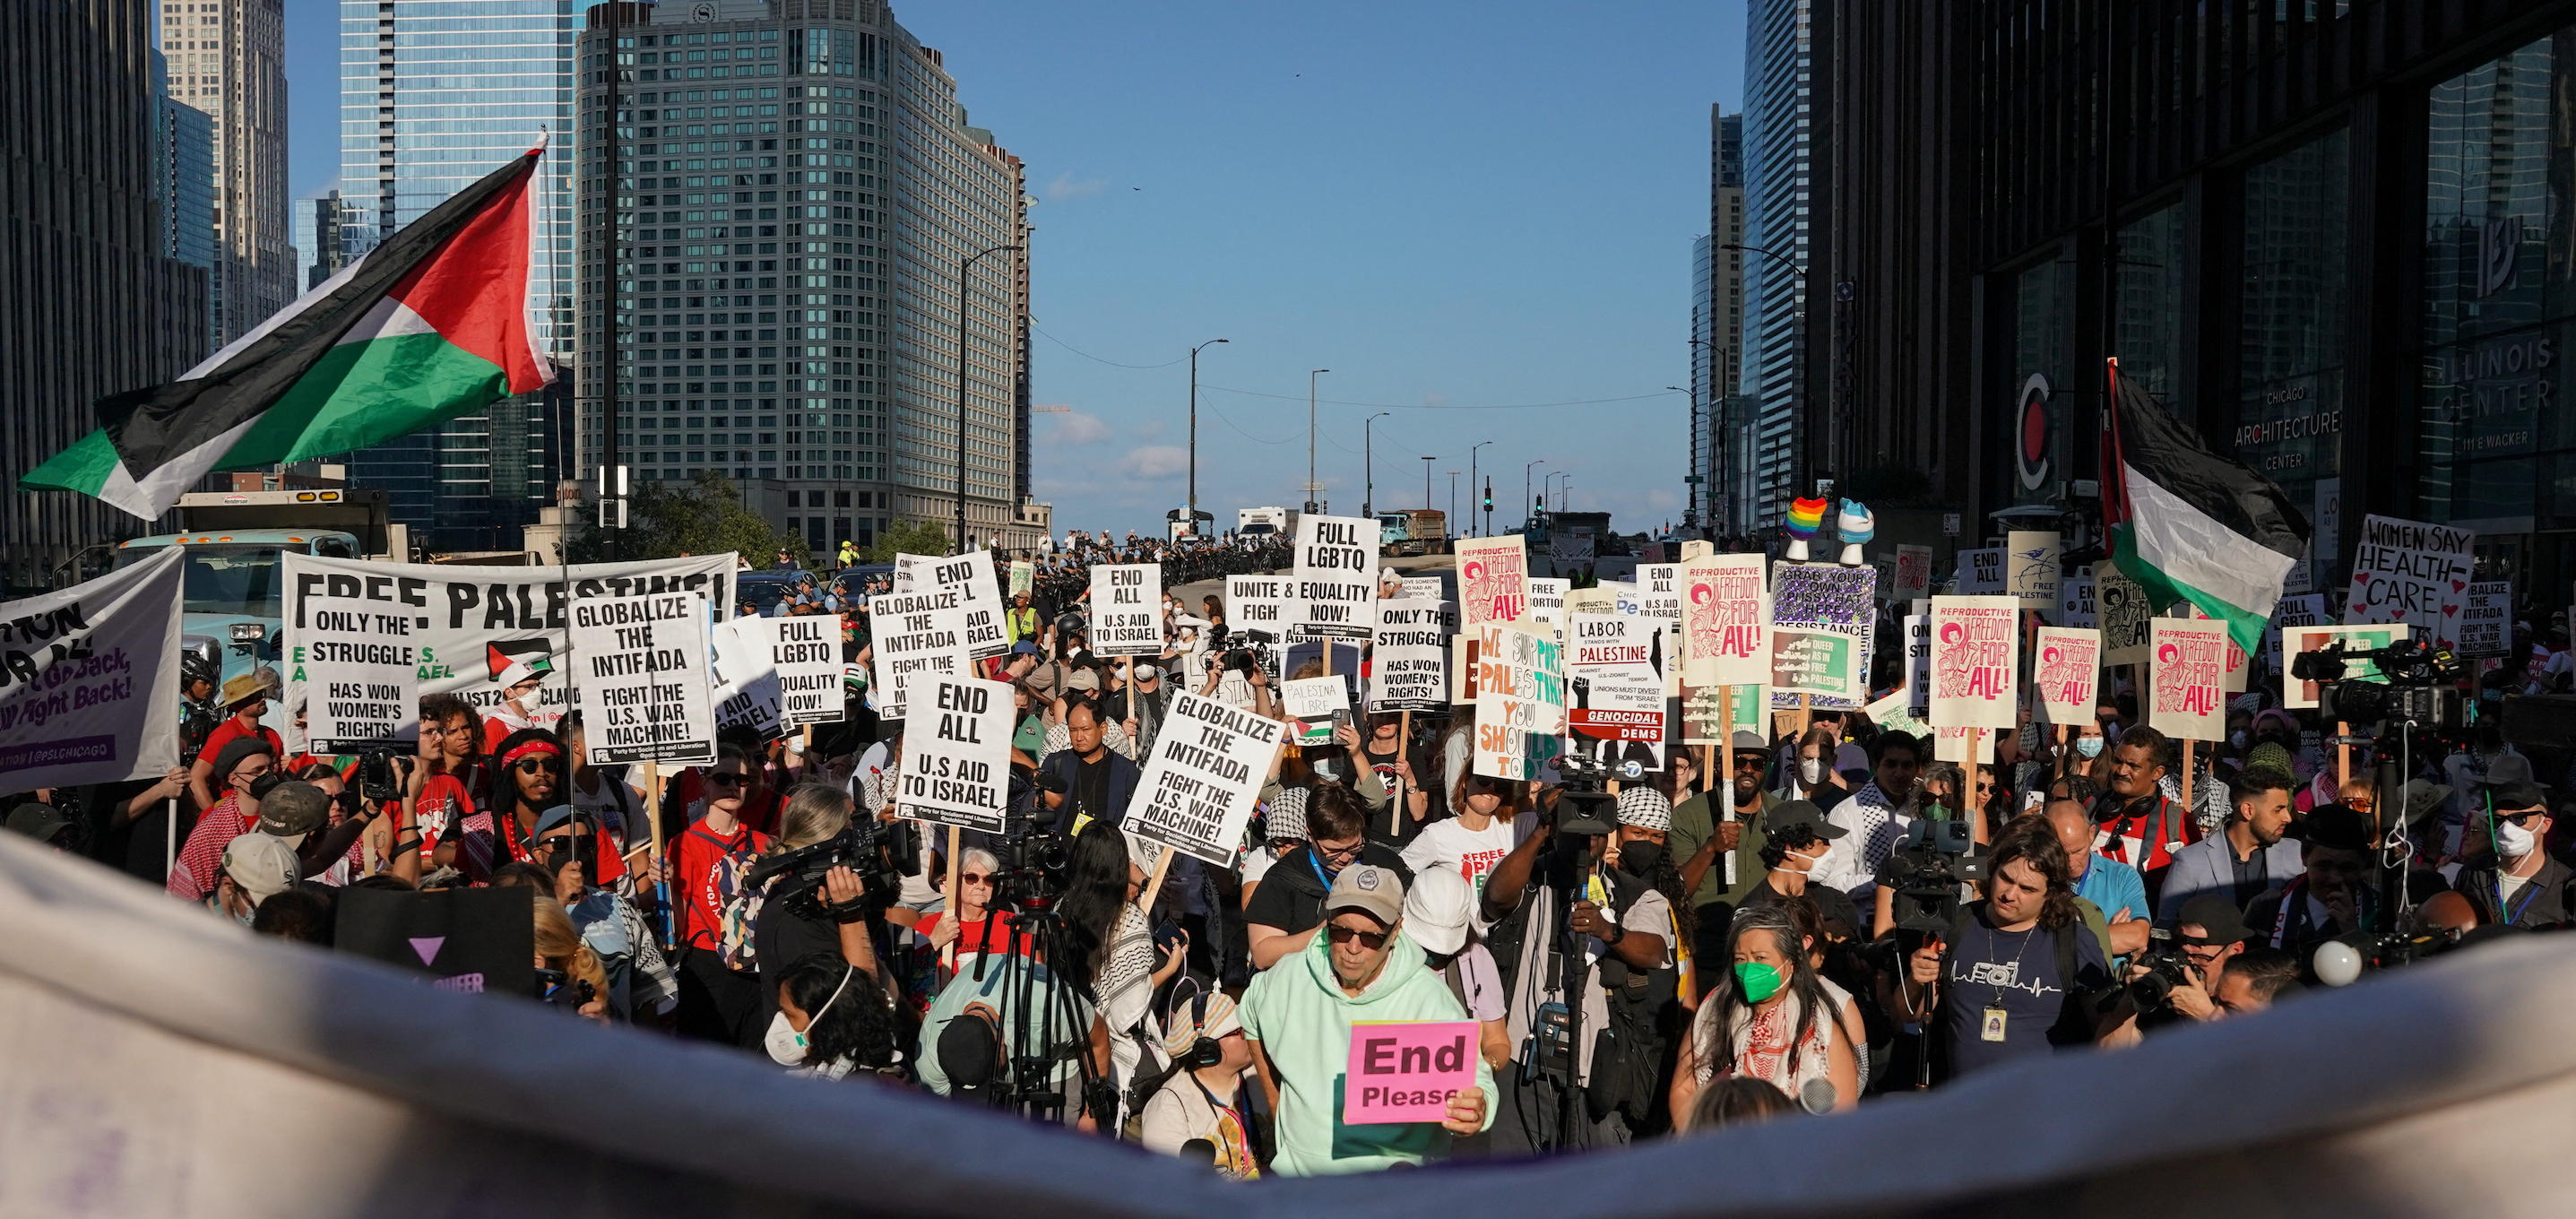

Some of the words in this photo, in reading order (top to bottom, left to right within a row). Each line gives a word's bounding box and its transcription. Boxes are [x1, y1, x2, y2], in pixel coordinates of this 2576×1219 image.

[1834, 311, 1858, 430] HYATT
[2442, 338, 2551, 385] ILLINOIS
[2267, 387, 2304, 405] CHICAGO
[2441, 380, 2549, 421] CENTER
[2235, 411, 2339, 447] ARCHITECTURE
[2462, 437, 2475, 451] 111
[2477, 437, 2484, 449] E
[2486, 431, 2529, 448] WACKER
[2266, 454, 2303, 471] CENTER
[1317, 522, 1358, 545] FULL
[2368, 519, 2425, 550] WOMEN
[2429, 526, 2470, 553] SAY
[1308, 546, 1364, 573] LGBTQ
[1462, 546, 1520, 557] REPRODUCTIVE
[1974, 552, 1999, 568] END
[936, 561, 973, 584] END
[1488, 554, 1522, 575] FREEDOM
[1650, 567, 1673, 579] END
[1690, 567, 1759, 577] REPRODUCTIVE
[2359, 546, 2467, 583] HEALTH-
[1111, 570, 1142, 585] END
[1498, 574, 1523, 594] FOR
[1783, 570, 1820, 582] GRAB
[1830, 572, 1864, 584] YOUR
[1976, 567, 1999, 583] ALL
[1114, 588, 1141, 604] ALL
[1234, 582, 1278, 598] UNITE
[1301, 582, 1370, 602] EQUALITY
[1532, 584, 1555, 594] FREE
[1653, 581, 1673, 592] ALL
[1719, 576, 1759, 600] FREEDOM
[1810, 583, 1841, 592] OWN
[2366, 578, 2437, 613] CARE
[875, 592, 958, 616] GLOBALIZE
[1491, 593, 1526, 621] ALL!
[1646, 599, 1661, 609] U.S
[1664, 599, 1678, 609] AID
[1787, 592, 1830, 603] PUSSY
[1835, 593, 1863, 603] HAT
[576, 597, 688, 627] GLOBALIZE
[967, 610, 990, 627] AID
[1310, 604, 1350, 622] NOW!
[1384, 610, 1421, 624] ONLY
[1426, 610, 1454, 627] THE
[1731, 601, 1759, 625] FOR
[1805, 604, 1840, 615] HERE
[1941, 608, 2012, 617] REPRODUCTIVE
[316, 610, 369, 633] ONLY
[376, 614, 409, 635] THE
[904, 614, 933, 631] THE
[1104, 614, 1125, 627] U.S
[1129, 613, 1149, 627] AID
[1579, 621, 1625, 637] LABOR
[1969, 618, 2012, 641] FREEDOM
[2485, 623, 2501, 632] THE
[616, 627, 654, 650] THE
[780, 622, 822, 642] FULL
[886, 630, 956, 653] INTIFADA
[1095, 629, 1111, 641] TO
[1115, 627, 1158, 641] ISRAEL
[1378, 631, 1452, 648] STRUGGLE
[1721, 626, 1761, 658] ALL!
[2044, 635, 2096, 646] REPRODUCTIVE
[2157, 629, 2221, 641] REPRODUCTIVE
[2460, 634, 2477, 643] U.S.
[2480, 633, 2500, 642] WAR
[314, 642, 412, 666] STRUGGLE
[773, 643, 830, 663] LGBTQ
[1481, 626, 1502, 658] WE
[1513, 631, 1562, 675] SUPPORT
[1580, 645, 1647, 661] PALESTINE
[1812, 640, 1834, 652] QUEER
[1979, 642, 2010, 666] FOR
[2063, 644, 2096, 663] FREEDOM
[2183, 640, 2222, 663] FREEDOM
[2459, 641, 2501, 652] MACHINE!
[592, 648, 687, 678] INTIFADA
[892, 658, 927, 674] FIGHT
[931, 656, 954, 670] THE
[1387, 661, 1409, 671] HAS
[1413, 660, 1440, 671] WON
[1811, 651, 1821, 661] AS
[1822, 653, 1830, 662] IN
[1811, 662, 1827, 673] FREE
[2070, 662, 2093, 682] FOR
[2193, 663, 2219, 687] FOR
[1480, 662, 1563, 708] PALESTINE
[1811, 674, 1846, 688] PALESTINE
[1967, 667, 2010, 700] ALL!
[18, 690, 69, 726] Fight
[73, 676, 132, 710] Back!
[330, 683, 362, 699] HAS
[367, 684, 401, 701] WON
[603, 686, 648, 706] FIGHT
[653, 683, 685, 703] THE
[938, 683, 988, 714] END
[1286, 684, 1336, 700] PALESINA
[1387, 687, 1432, 697] RIGHTS!
[2060, 681, 2090, 706] ALL!
[2183, 686, 2219, 716] ALL!
[608, 708, 639, 726] U.S.
[645, 704, 685, 722] WAR
[1302, 700, 1330, 713] LBRE
[1503, 699, 1535, 727] YOU
[1176, 696, 1277, 744] GLOBALIZE
[1587, 711, 1658, 723] GENOCIDAL
[336, 722, 395, 739] RIGHTS!
[607, 722, 691, 746] MACHINE!
[938, 713, 981, 744] ALL
[1621, 729, 1658, 739] DEMS
[1199, 726, 1235, 755] THE
[1480, 723, 1559, 760] SHOULD
[34, 743, 108, 762] @PSLCHICAGO
[1164, 740, 1249, 785] INTIFADA
[920, 754, 950, 777] U.S
[956, 759, 989, 783] AID
[1498, 756, 1543, 781] TOO!
[1616, 763, 1628, 773] abc
[903, 774, 925, 797] TO
[932, 779, 998, 809] ISRAEL
[1159, 770, 1204, 798] FIGHT
[1205, 784, 1234, 808] THE
[1154, 788, 1181, 810] U.S.
[1188, 799, 1225, 825] WAR
[1144, 804, 1222, 843] MACHINE!
[1472, 849, 1507, 860] FREE
[1363, 1035, 1465, 1075] End
[1362, 1086, 1459, 1107] Please
